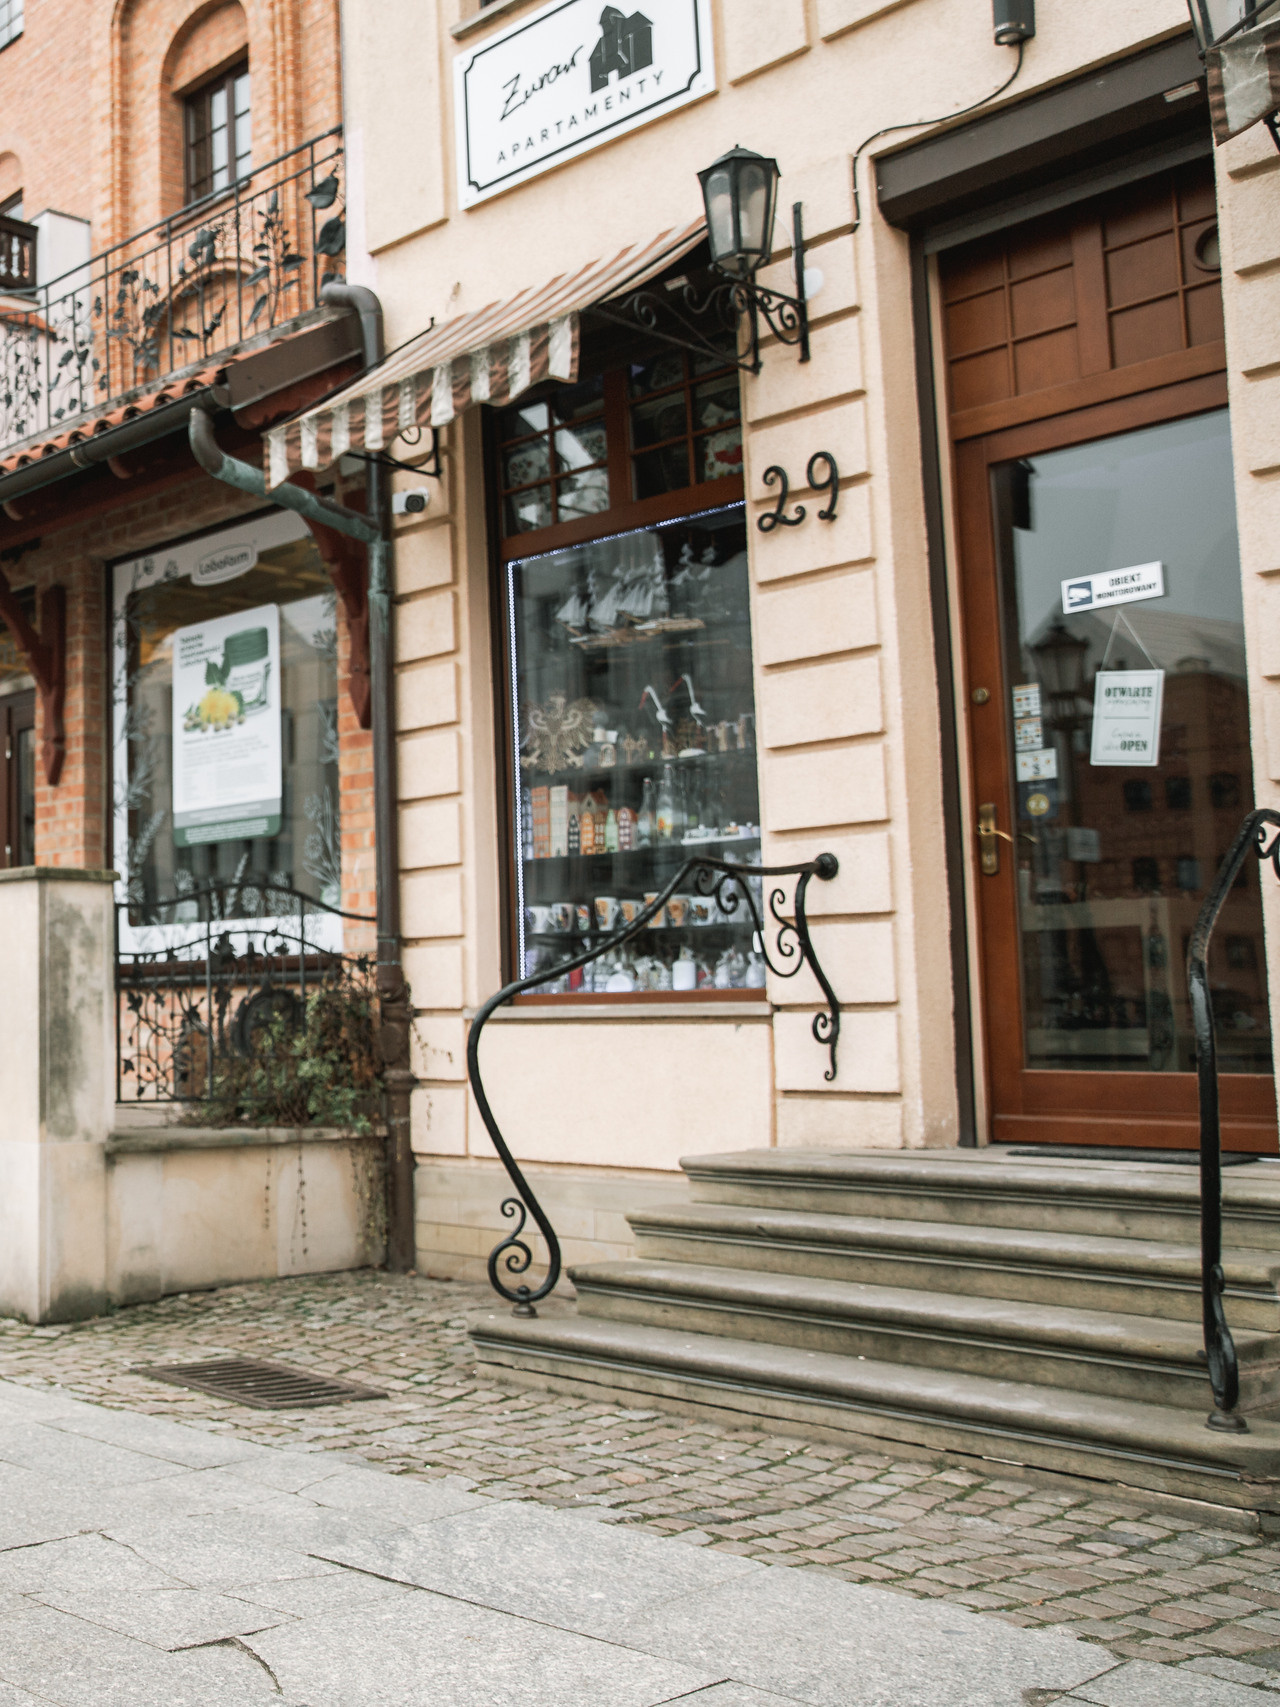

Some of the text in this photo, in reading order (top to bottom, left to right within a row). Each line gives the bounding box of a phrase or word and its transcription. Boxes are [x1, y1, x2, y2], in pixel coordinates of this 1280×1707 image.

[497, 70, 664, 164] APARTAMENTY
[757, 451, 838, 533] 29
[1109, 573, 1141, 587] OBIEKT
[1096, 582, 1157, 599] MONITOROWANY
[1104, 686, 1153, 698] OTWARTE
[1120, 740, 1148, 752] OPEN
